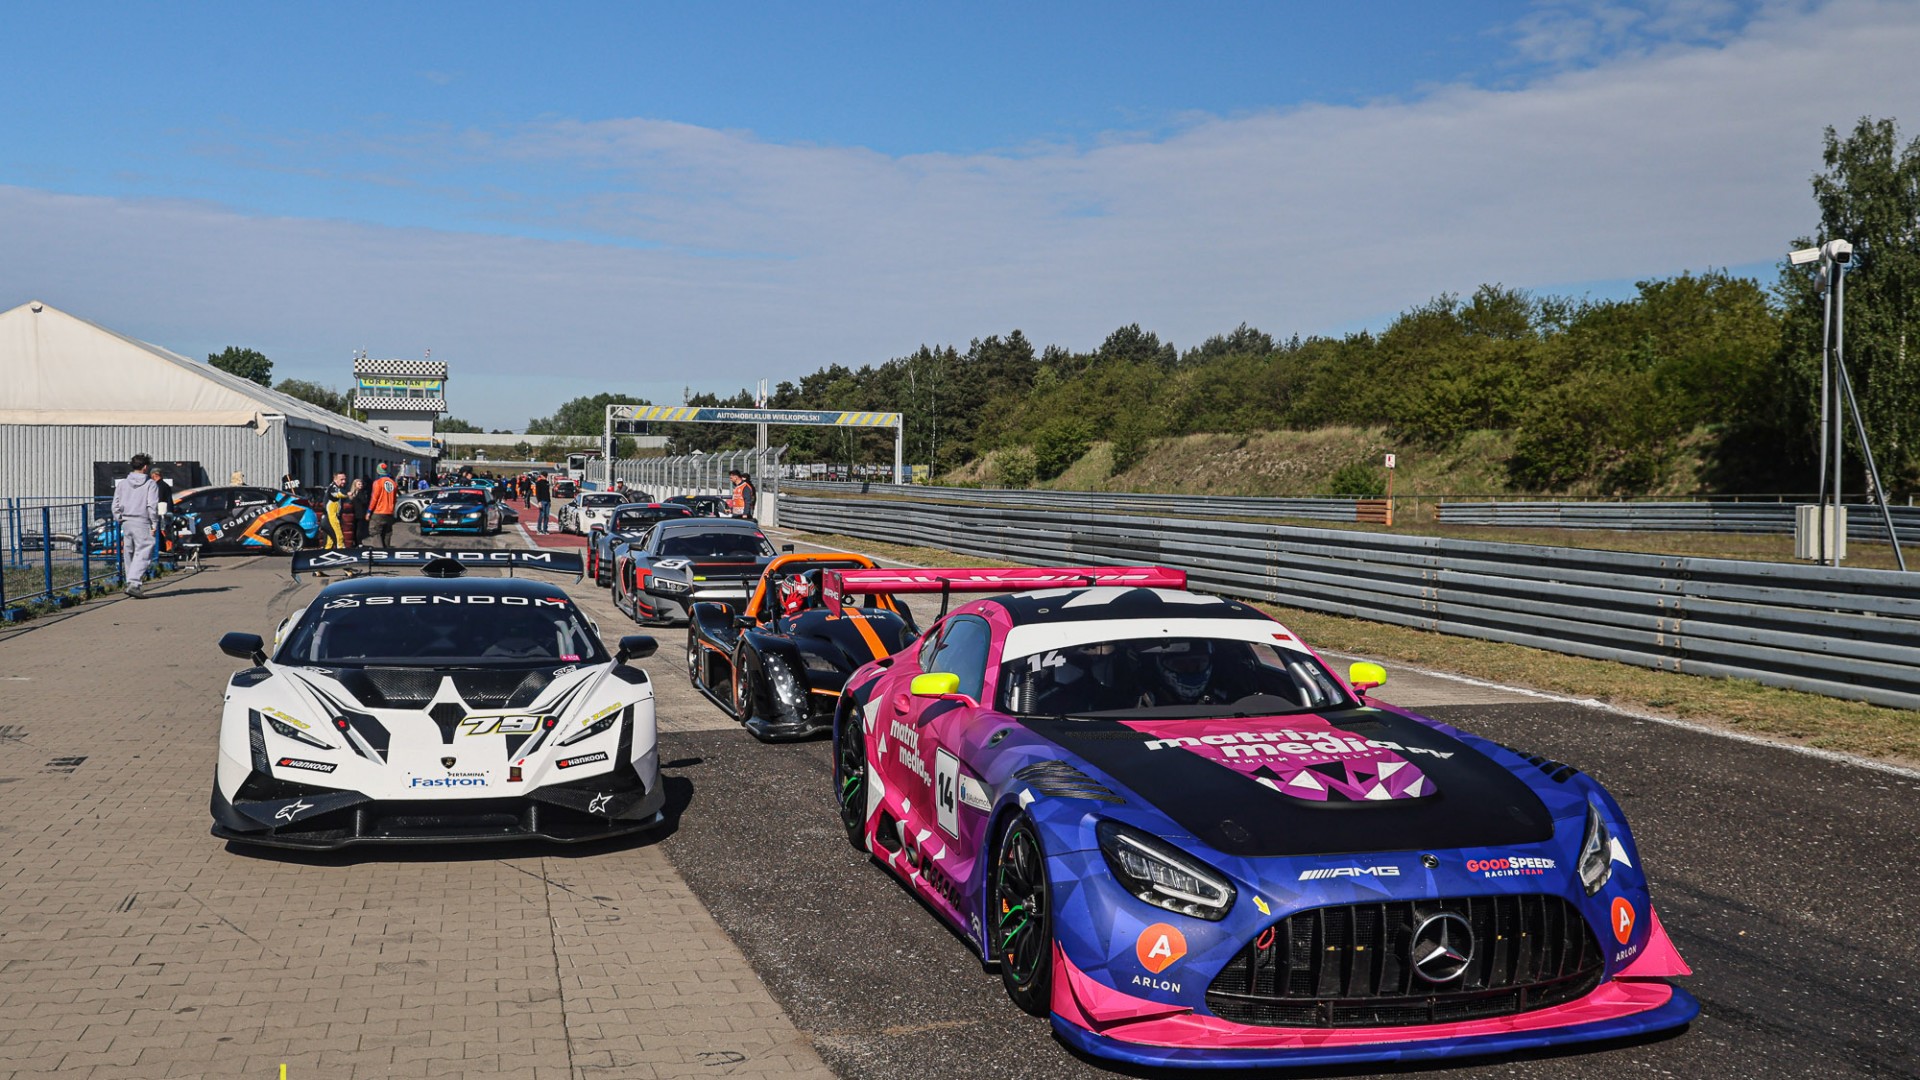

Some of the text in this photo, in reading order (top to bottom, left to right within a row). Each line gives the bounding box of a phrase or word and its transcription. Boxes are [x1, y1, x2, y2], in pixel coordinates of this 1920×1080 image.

[717, 412, 771, 420] AUTOMOBILKLUB
[222, 503, 275, 530] COMPUTEX
[361, 550, 551, 563] SENDOM
[365, 595, 566, 609] SENDOM
[1027, 650, 1067, 673] 14
[461, 715, 541, 736] 79
[890, 719, 919, 750] matrix
[1144, 728, 1331, 751] matrix
[1299, 750, 1383, 761] RESELLER
[412, 777, 486, 788] Fastron
[938, 771, 954, 814] 14
[1615, 944, 1637, 962] ARLON
[1131, 975, 1181, 993] ARLON
